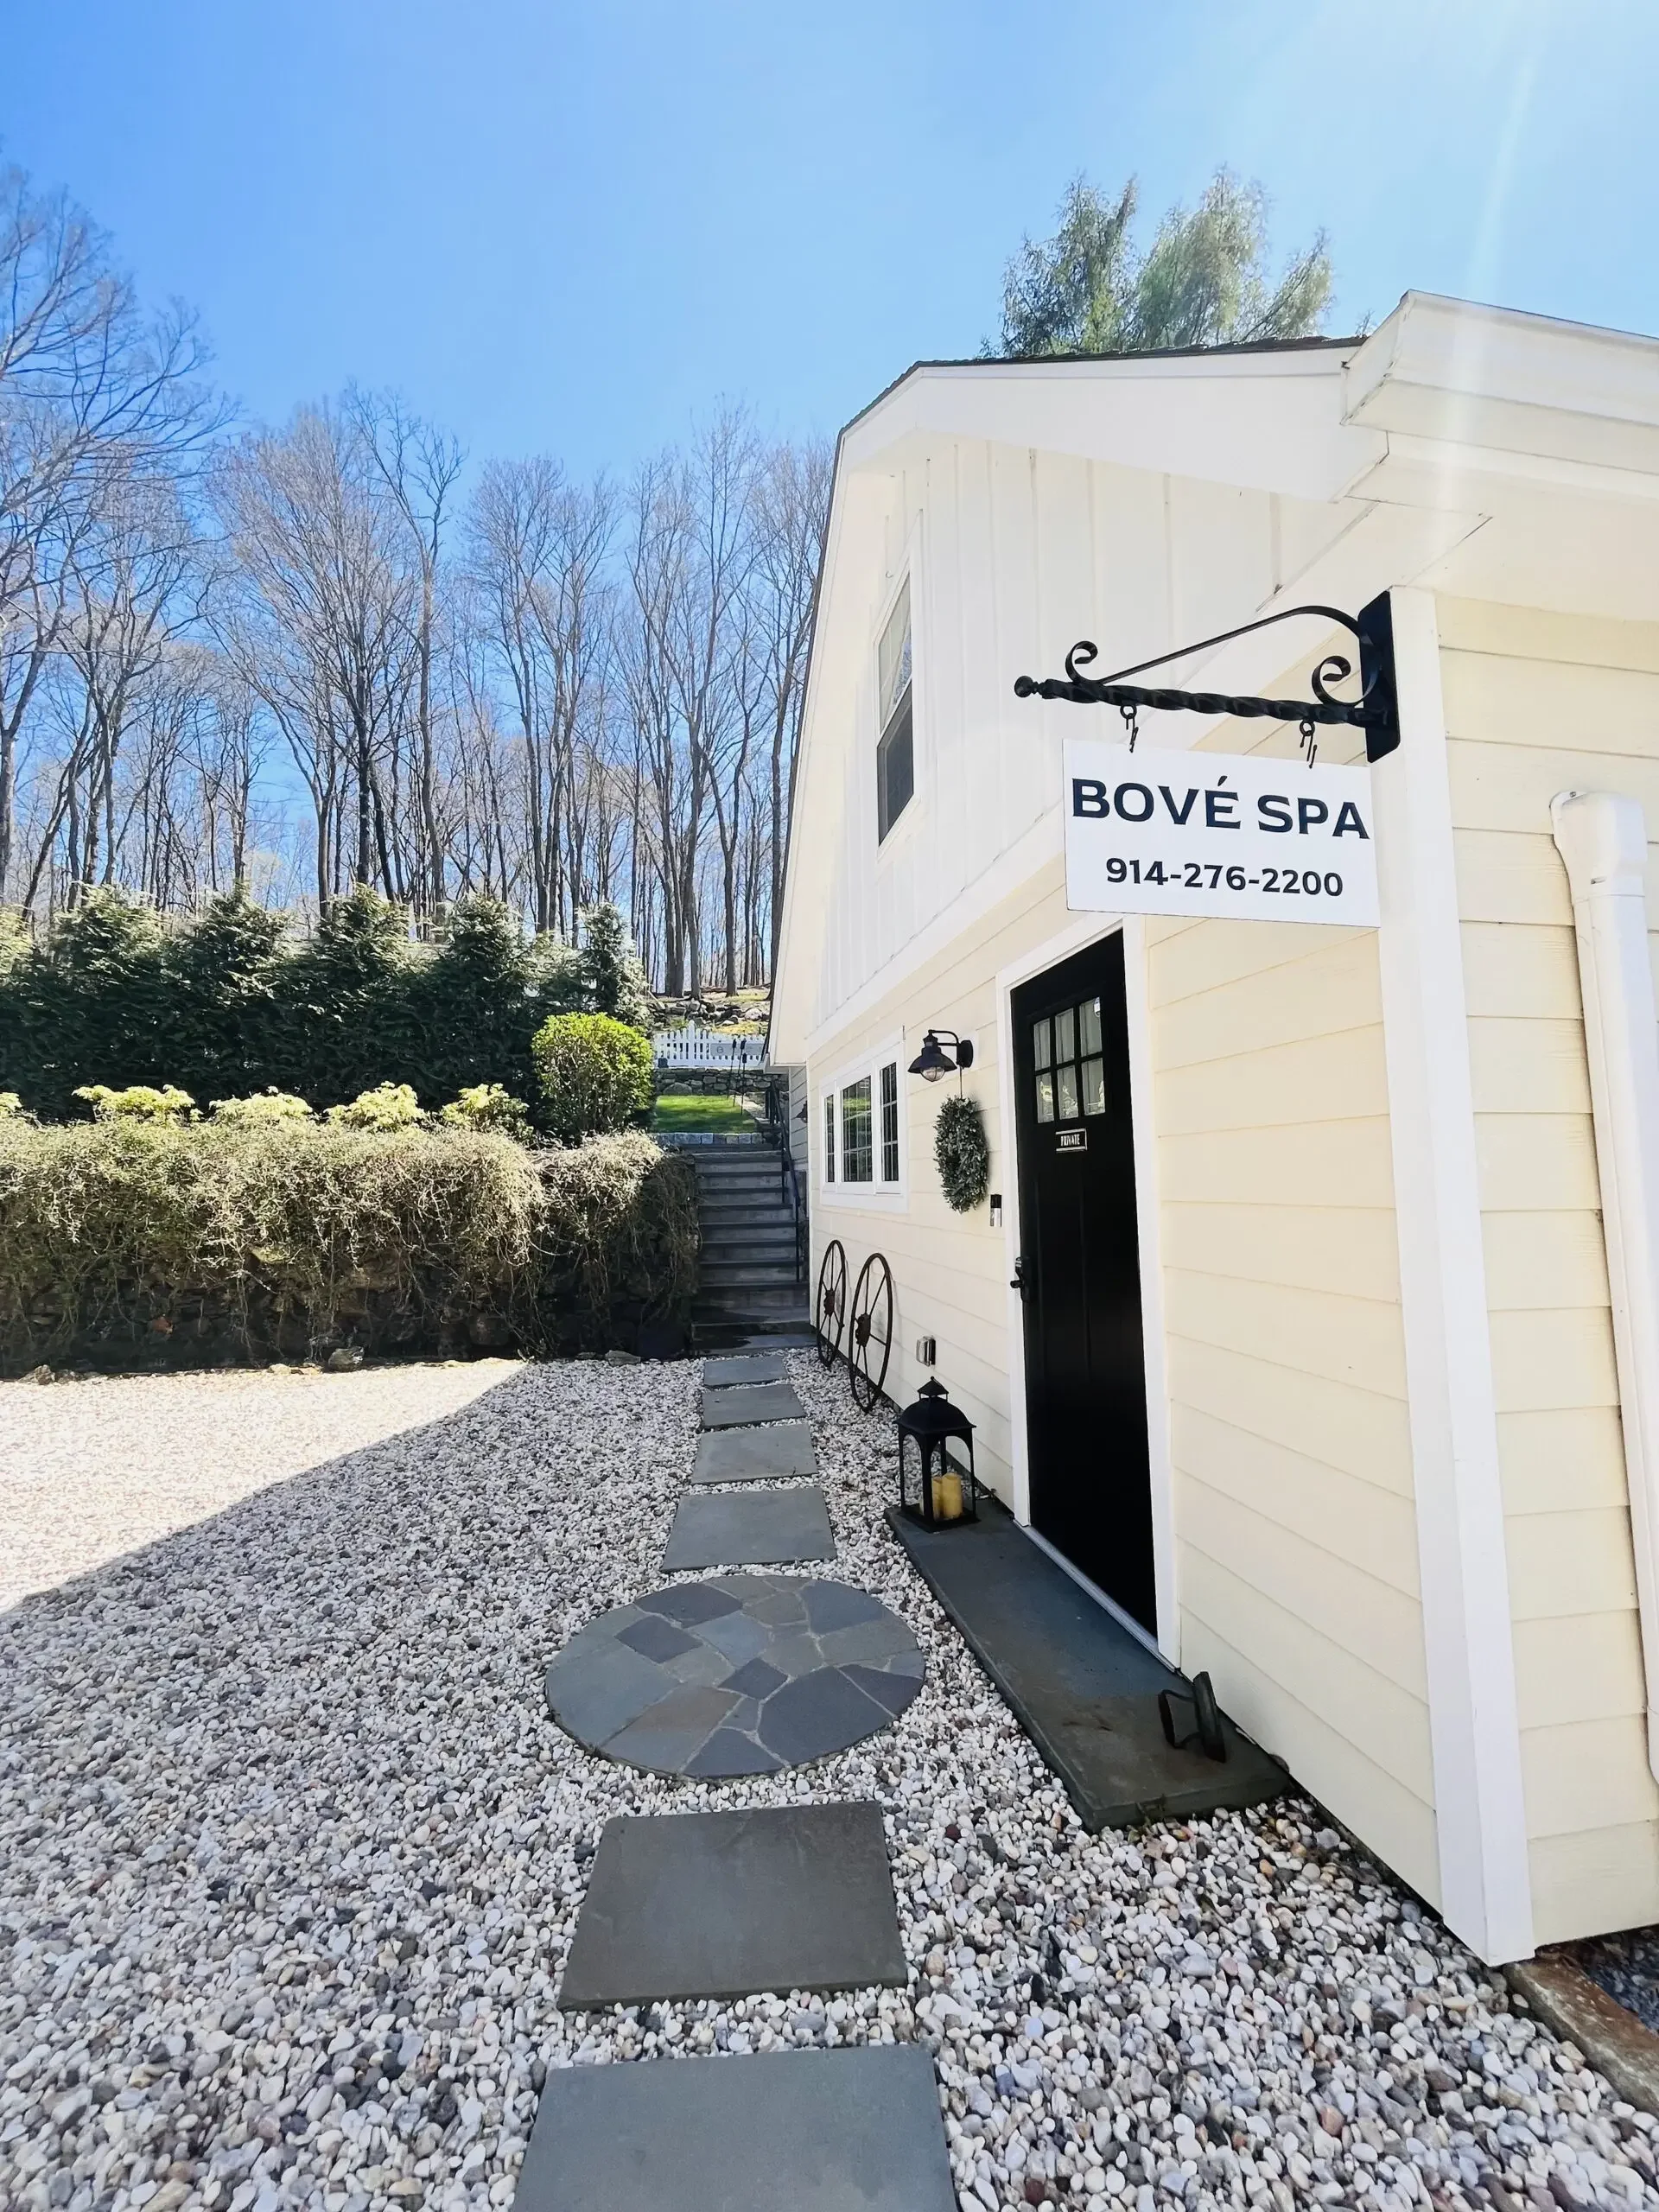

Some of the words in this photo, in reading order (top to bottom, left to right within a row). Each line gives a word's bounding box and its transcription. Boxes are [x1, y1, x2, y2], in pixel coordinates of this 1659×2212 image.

[1071, 775, 1242, 830] BOVÉ
[1257, 794, 1370, 840] SPA
[1106, 857, 1344, 897] 914-276-2200
